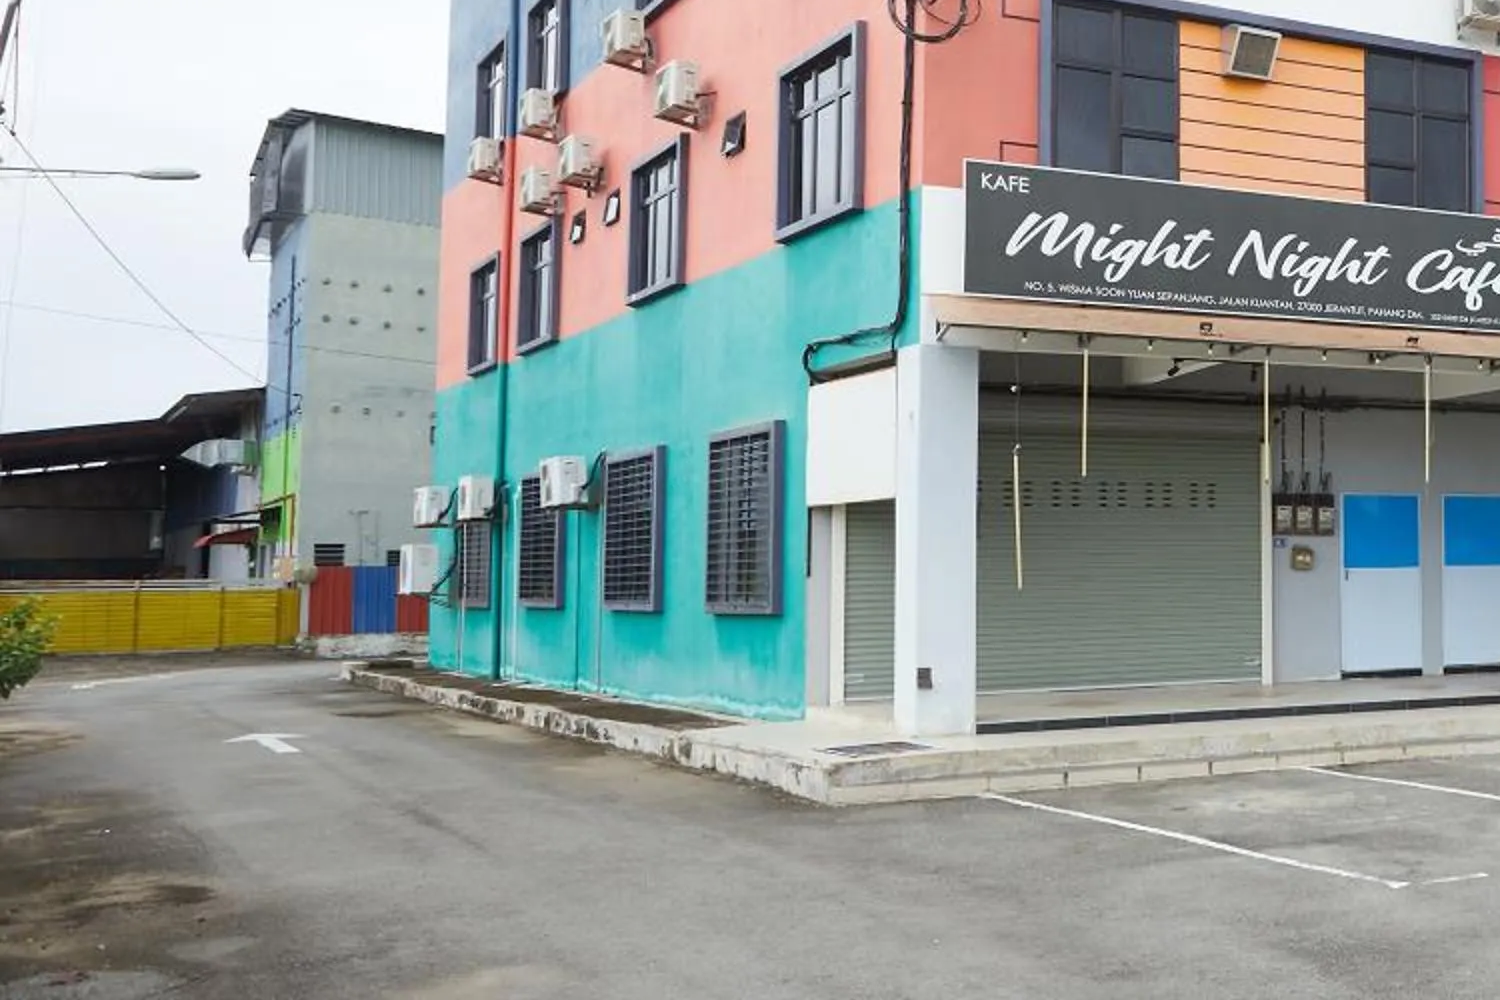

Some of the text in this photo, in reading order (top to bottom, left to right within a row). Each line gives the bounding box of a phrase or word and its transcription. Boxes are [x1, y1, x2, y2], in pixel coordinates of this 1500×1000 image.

[980, 171, 1030, 194] KAFE
[1005, 211, 1213, 283] Might
[1227, 229, 1391, 297] Night
[1059, 284, 1093, 296] WISMA
[1095, 287, 1125, 298] SOON
[1127, 289, 1155, 300] YUAN
[1219, 295, 1249, 307] JALAN
